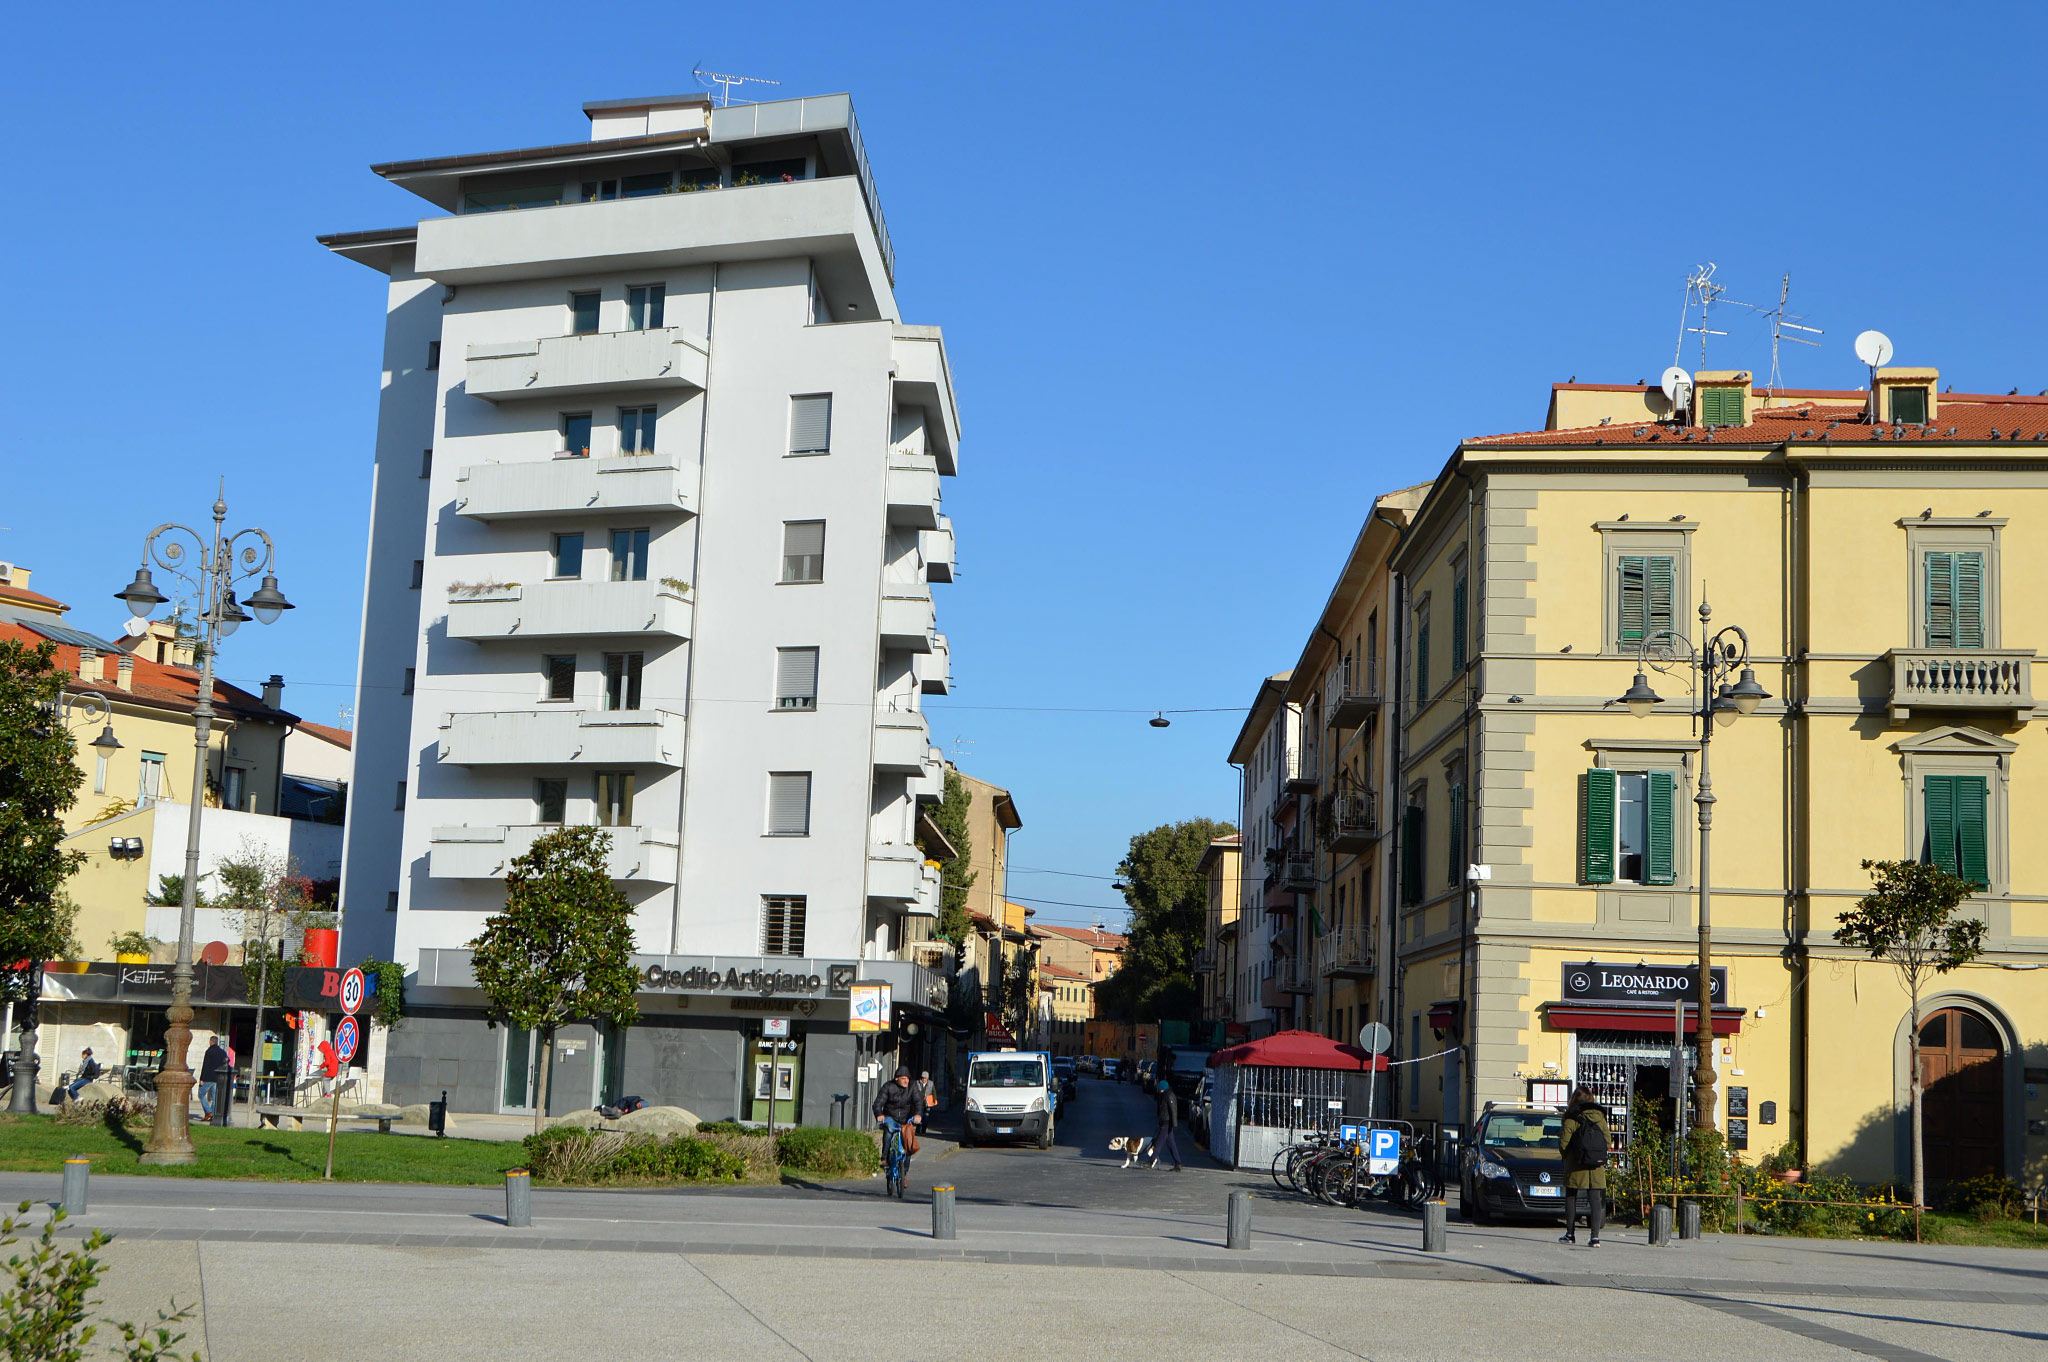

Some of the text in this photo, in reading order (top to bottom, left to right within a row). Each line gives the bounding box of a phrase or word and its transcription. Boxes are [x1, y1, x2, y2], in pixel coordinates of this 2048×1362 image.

[320, 970, 378, 998] BR
[345, 981, 359, 1002] 30
[647, 964, 821, 995] Credito Artigiano
[1600, 971, 1689, 990] LEONARDO
[1375, 1132, 1394, 1156] P
